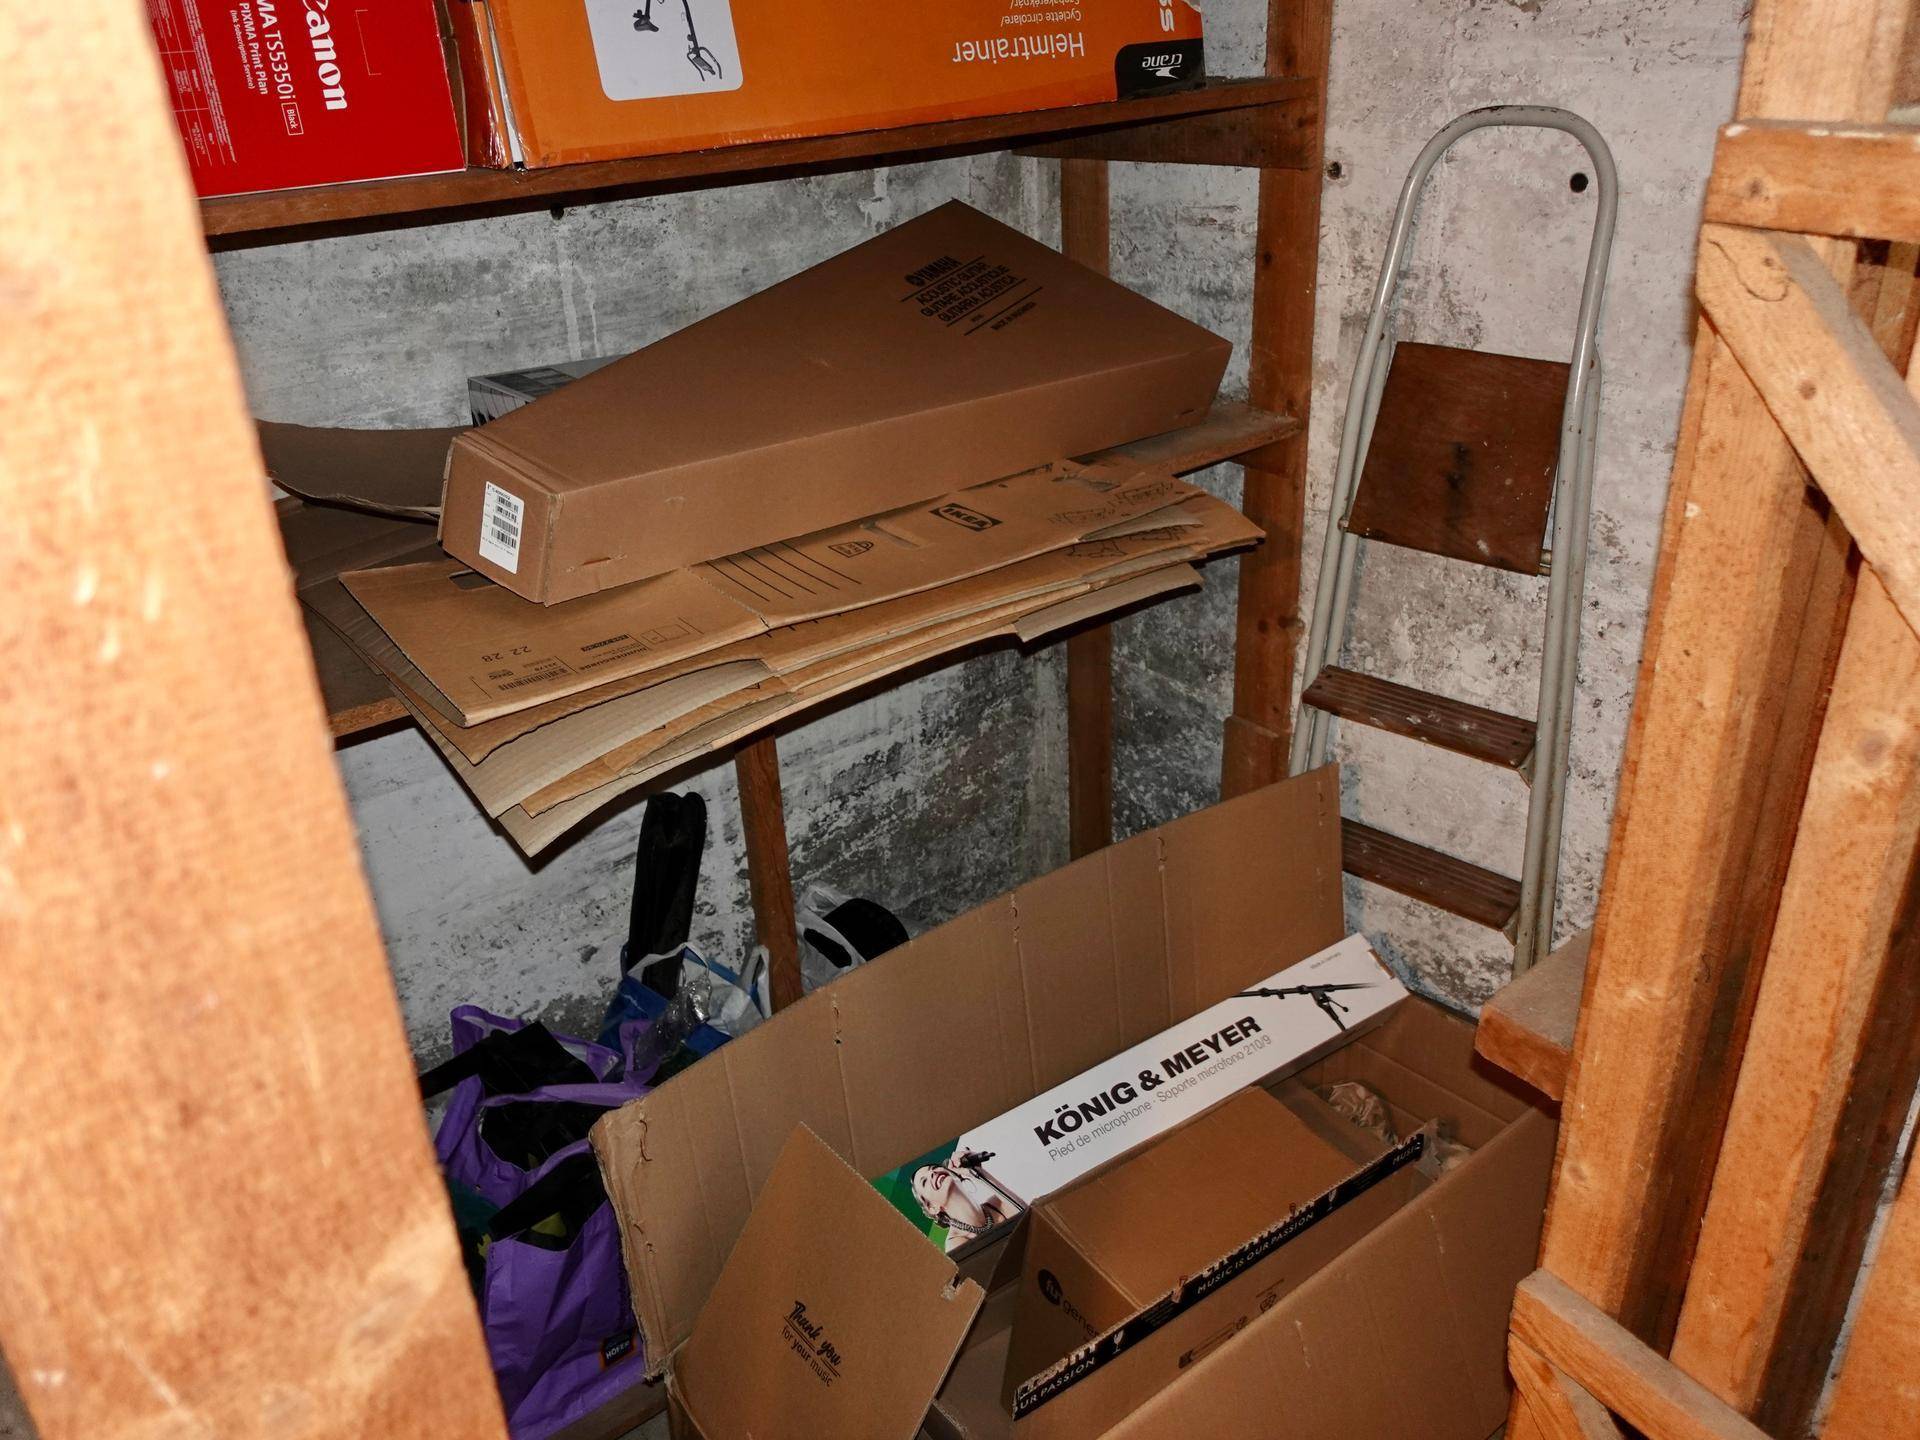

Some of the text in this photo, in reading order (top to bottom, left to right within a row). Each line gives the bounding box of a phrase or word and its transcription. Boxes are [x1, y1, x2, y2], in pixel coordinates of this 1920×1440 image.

[239, 2, 269, 95] PIXMA Print Plan
[952, 31, 1085, 65] Heimtrainer
[1000, 8, 1082, 28] Cyclette circolare/
[264, 30, 295, 100] TS5350i
[286, 108, 298, 129] Black
[1142, 53, 1183, 69] crane
[940, 507, 992, 529] IKEA
[1034, 1015, 1263, 1146] KÖNIG & MEYER
[1048, 1138, 1076, 1161] Pied
[1075, 1129, 1092, 1149] de
[1092, 1101, 1152, 1138] microphone
[1156, 1076, 1198, 1104] Soporte
[1197, 1265, 1233, 1295] MUSIC
[1270, 1211, 1314, 1245] PASSION
[781, 1325, 834, 1388] for your music
[788, 1300, 842, 1367] Thank you
[1040, 1356, 1095, 1397] PASSION
